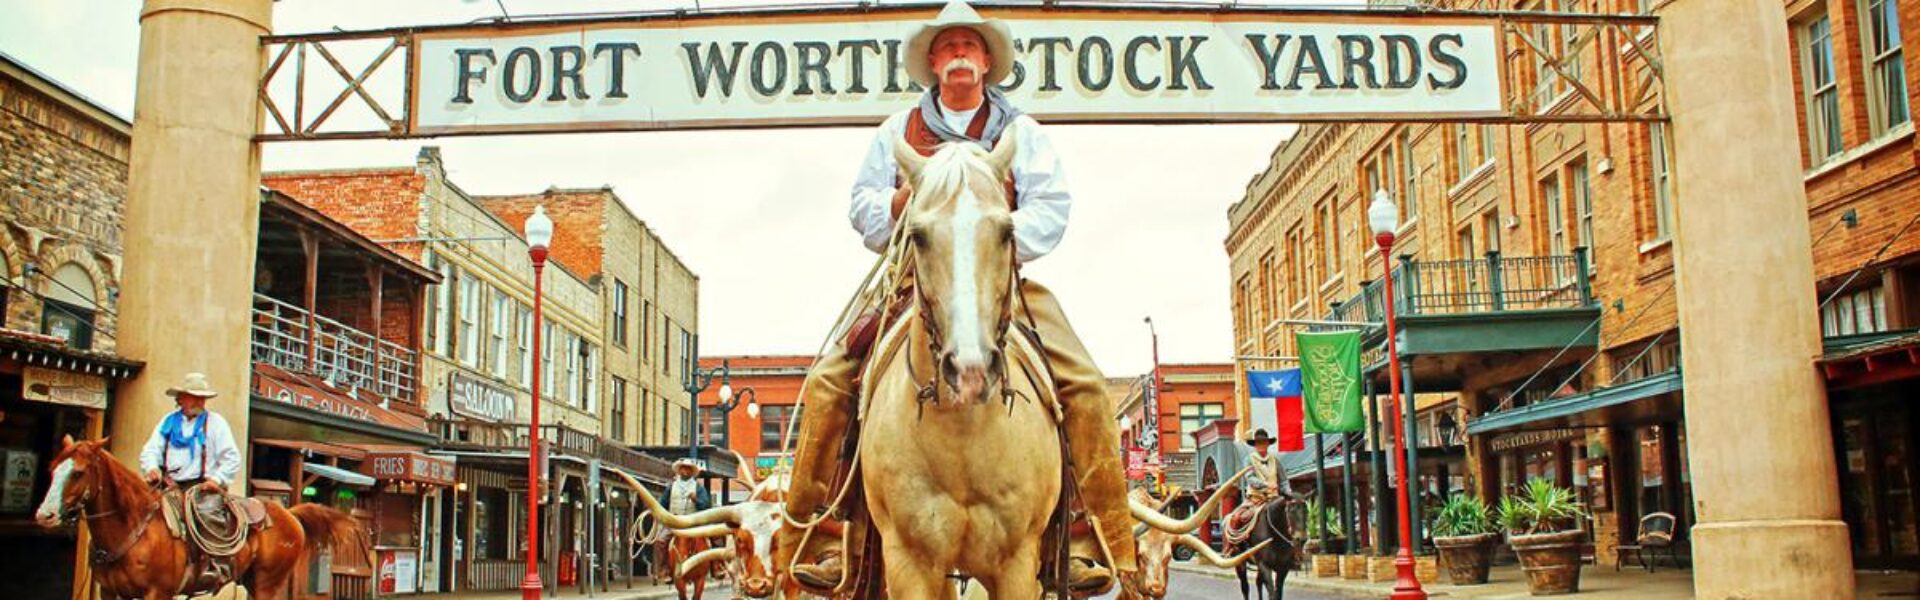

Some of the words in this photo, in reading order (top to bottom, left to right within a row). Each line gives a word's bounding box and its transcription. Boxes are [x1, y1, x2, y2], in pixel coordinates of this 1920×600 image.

[451, 43, 641, 104] FORT
[682, 39, 923, 98] WORTH
[1245, 33, 1468, 90] YARDS
[373, 457, 405, 475] FRIES
